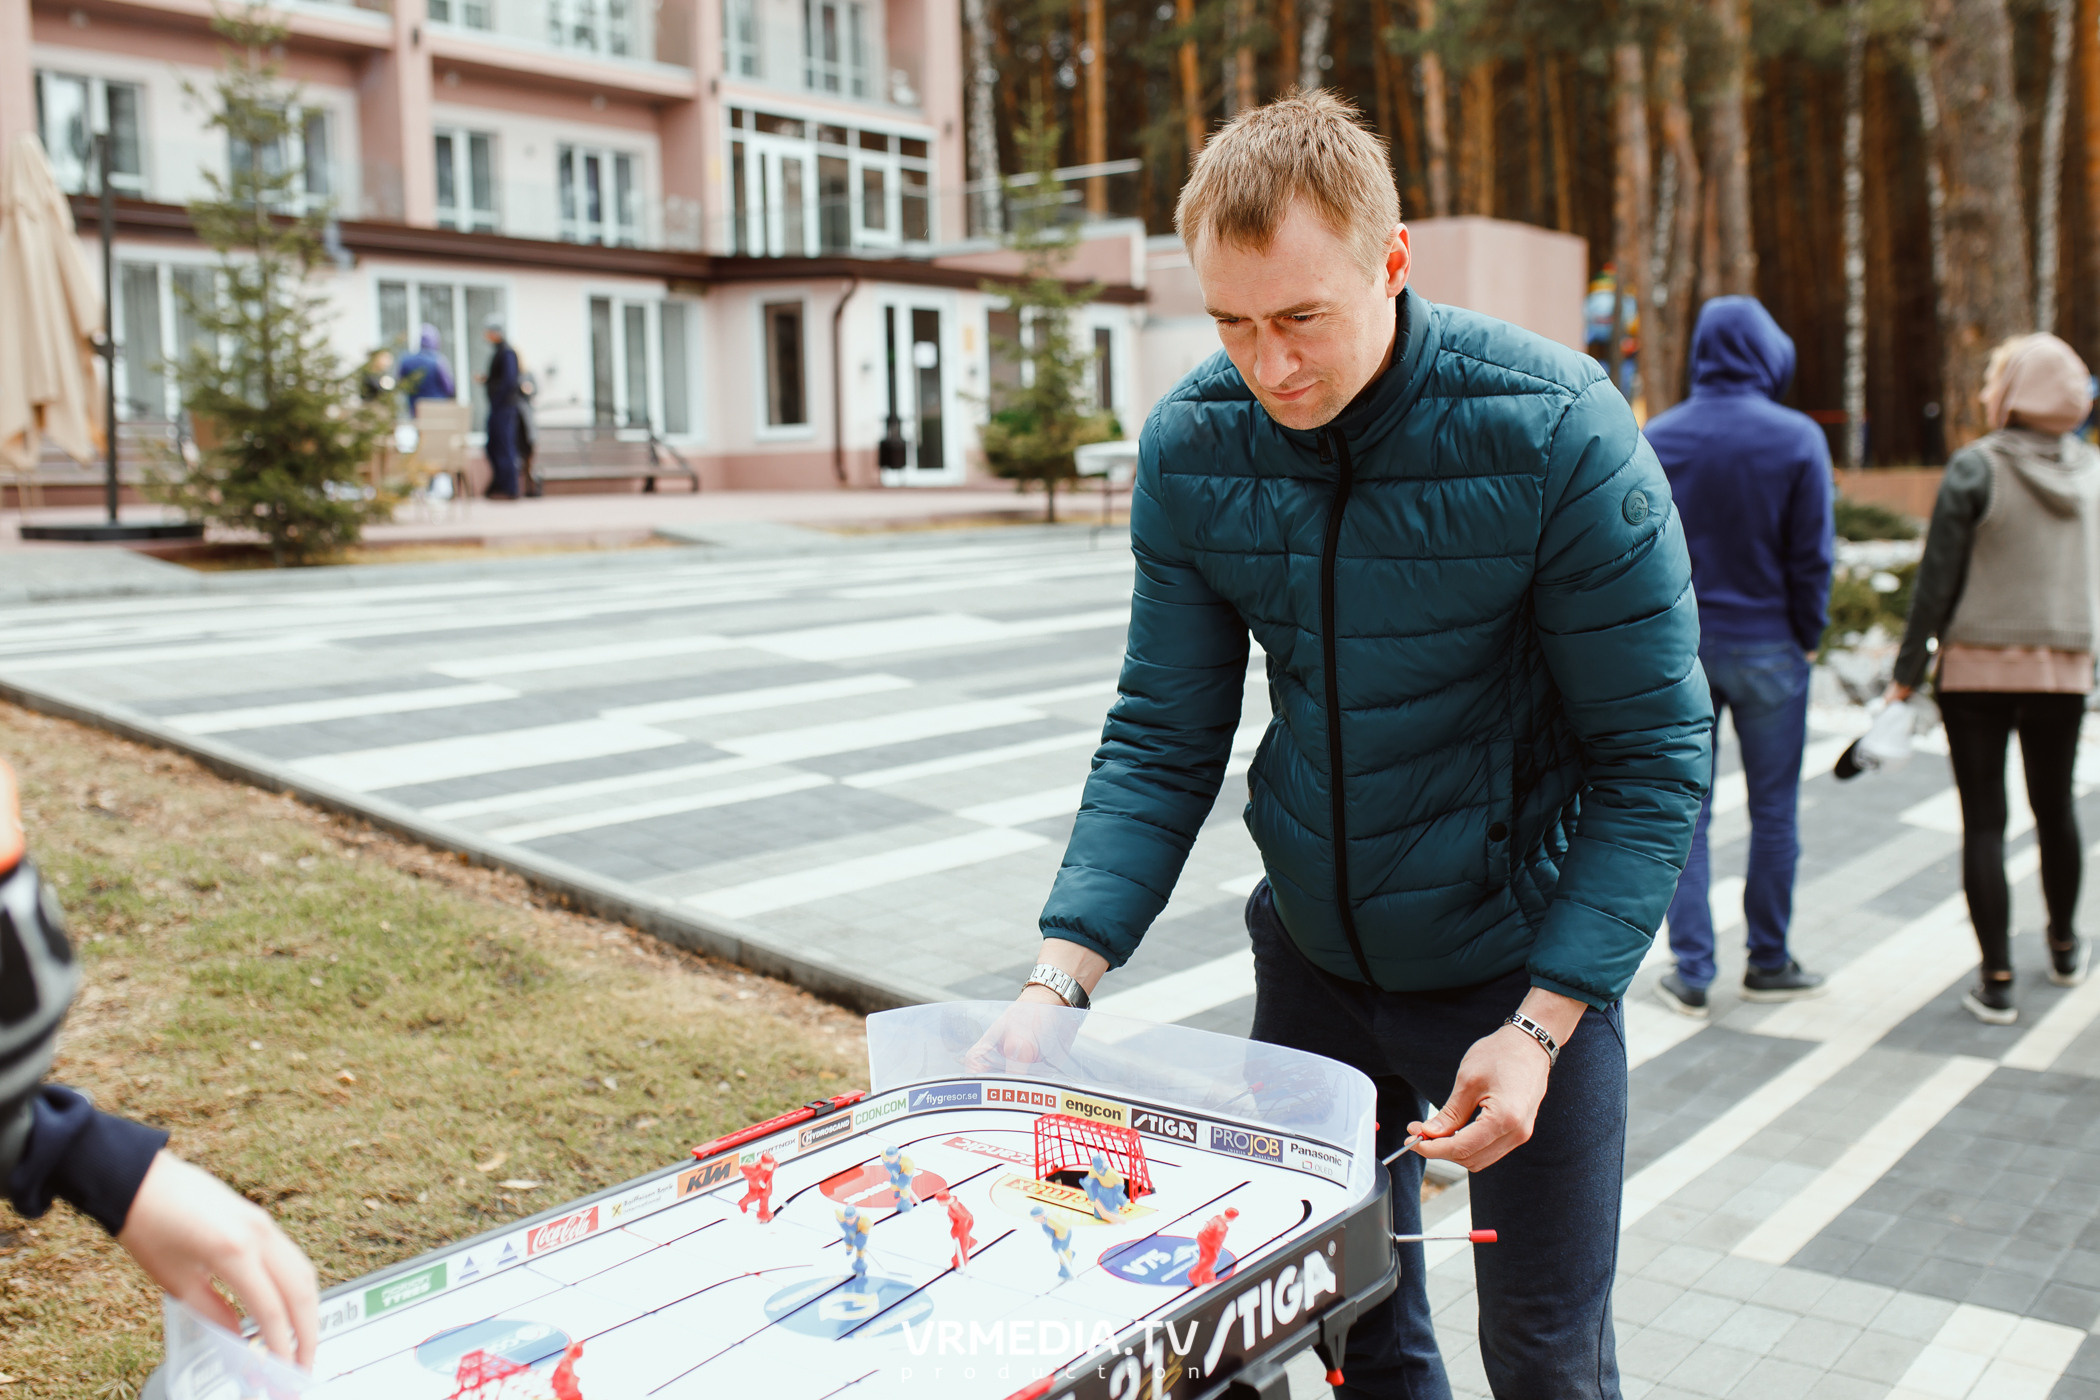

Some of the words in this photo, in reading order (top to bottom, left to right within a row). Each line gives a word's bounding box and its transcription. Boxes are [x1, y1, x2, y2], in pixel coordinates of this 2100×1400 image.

[926, 1091, 978, 1106] flygresor.se
[988, 1089, 1056, 1107] CRAMO
[1065, 1099, 1122, 1121] engcon
[855, 1098, 907, 1126] CDON.COM
[1134, 1112, 1195, 1141] STIGA
[1213, 1127, 1281, 1157] PROJOB
[1290, 1142, 1342, 1166] Panasonic
[686, 1161, 732, 1194] KTM
[1314, 1163, 1334, 1176] OLED
[1203, 1249, 1337, 1377] STIGA
